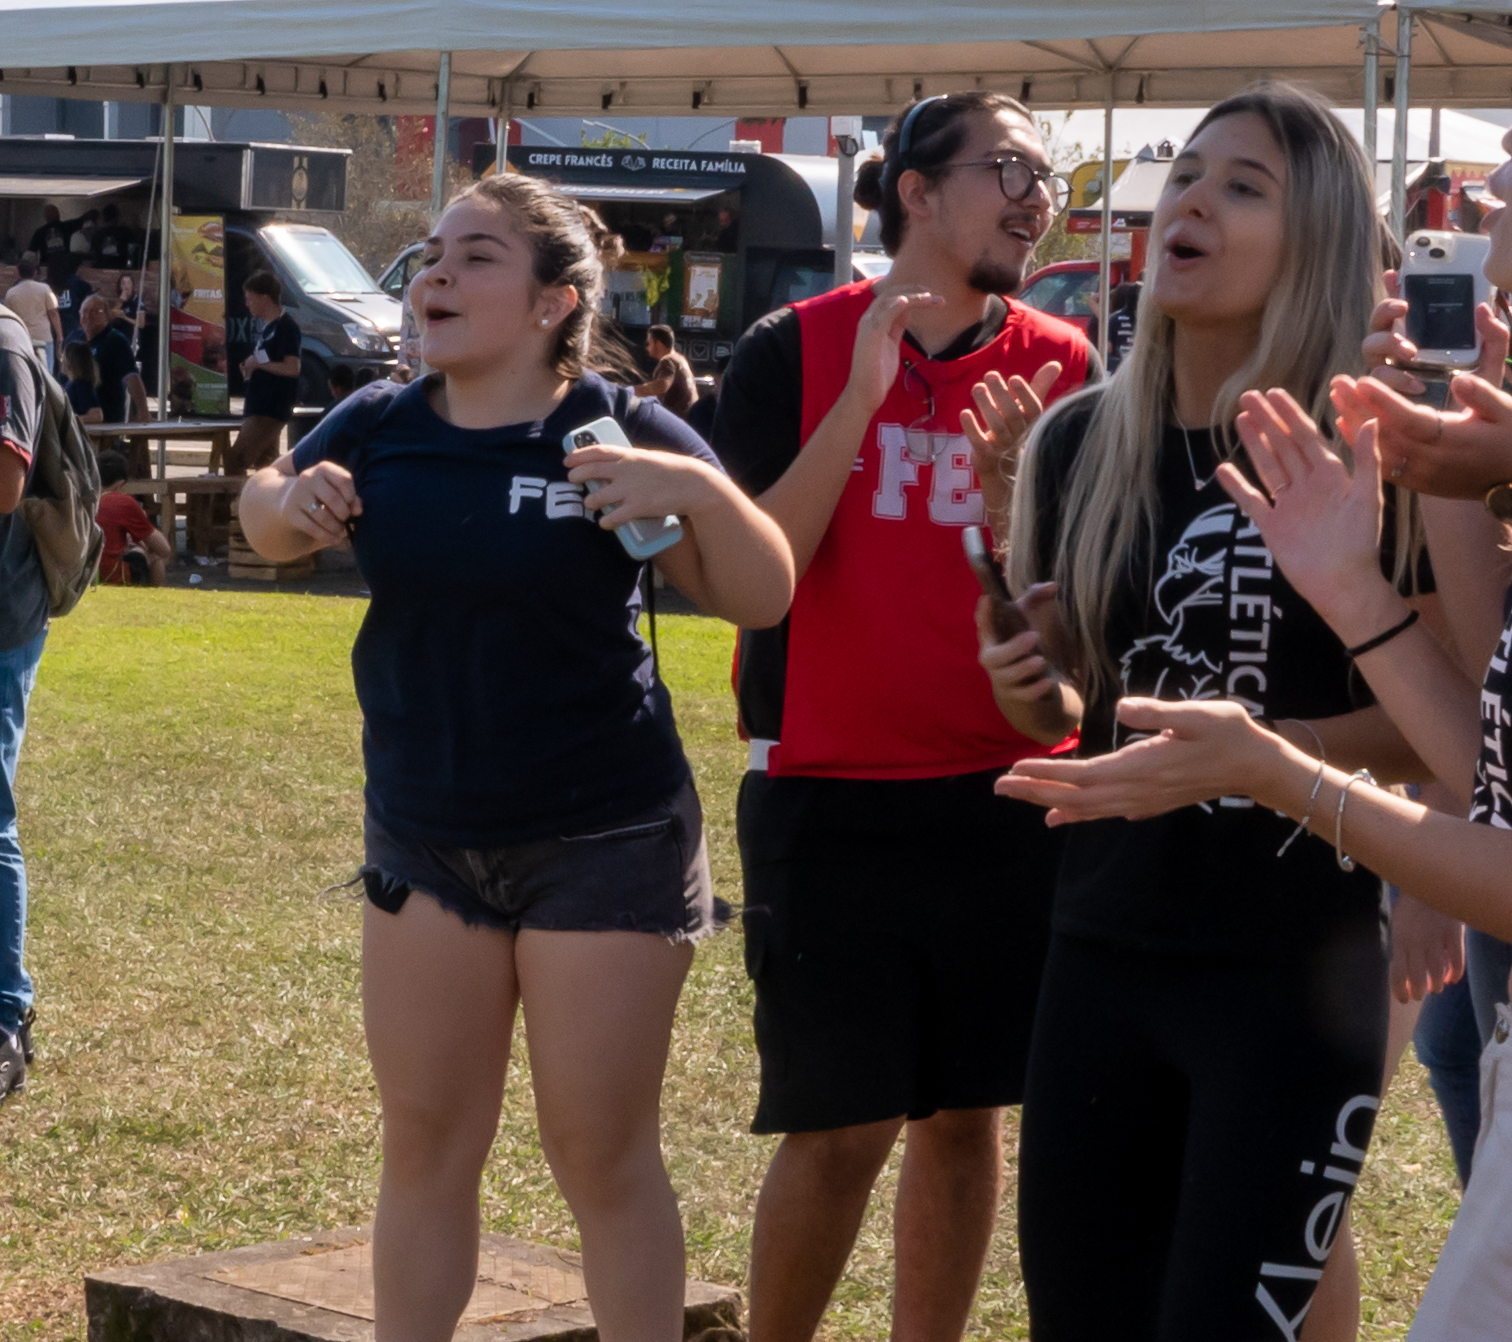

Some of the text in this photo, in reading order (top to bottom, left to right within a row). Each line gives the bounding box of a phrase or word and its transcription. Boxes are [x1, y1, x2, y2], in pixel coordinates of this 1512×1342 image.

[529, 153, 613, 168] CREPE FRANCÊS
[652, 157, 746, 173] RECEITA FAMÍLIA
